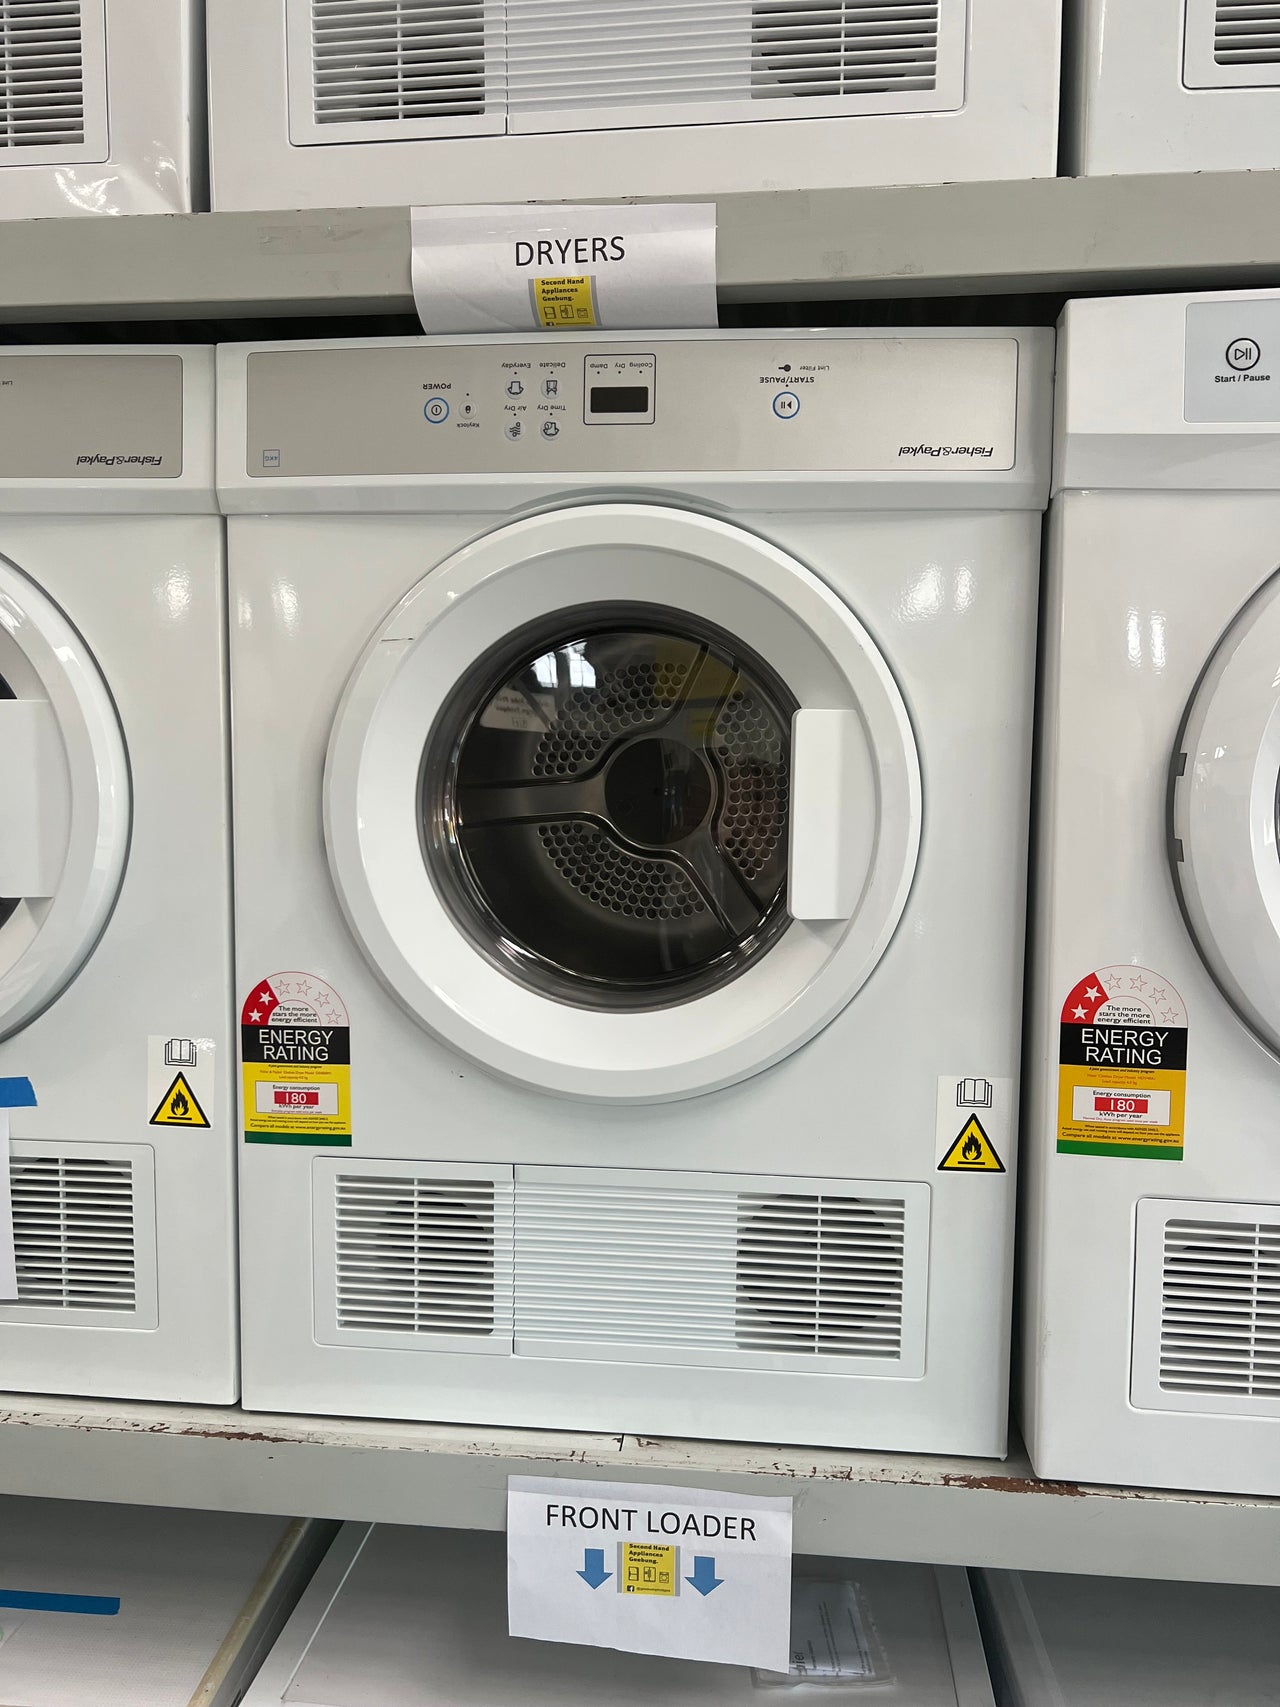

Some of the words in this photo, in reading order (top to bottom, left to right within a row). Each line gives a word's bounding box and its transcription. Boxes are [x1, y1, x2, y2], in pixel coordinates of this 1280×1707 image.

[515, 235, 625, 266] DRYERS
[541, 287, 578, 295] Appliances
[1214, 375, 1236, 383] Start
[898, 443, 994, 457] Fisher&Paykel
[76, 453, 162, 466] Fisher&Paykel
[259, 1029, 333, 1045] ENERGY
[1081, 1028, 1169, 1047] ENERGY
[263, 1045, 329, 1061] RATING
[1086, 1046, 1162, 1065] RATING
[285, 1092, 307, 1104] 180
[1110, 1099, 1135, 1111] 180
[546, 1504, 638, 1531] FRONT
[647, 1510, 757, 1541] LOADER
[628, 1550, 663, 1558] Appliances
